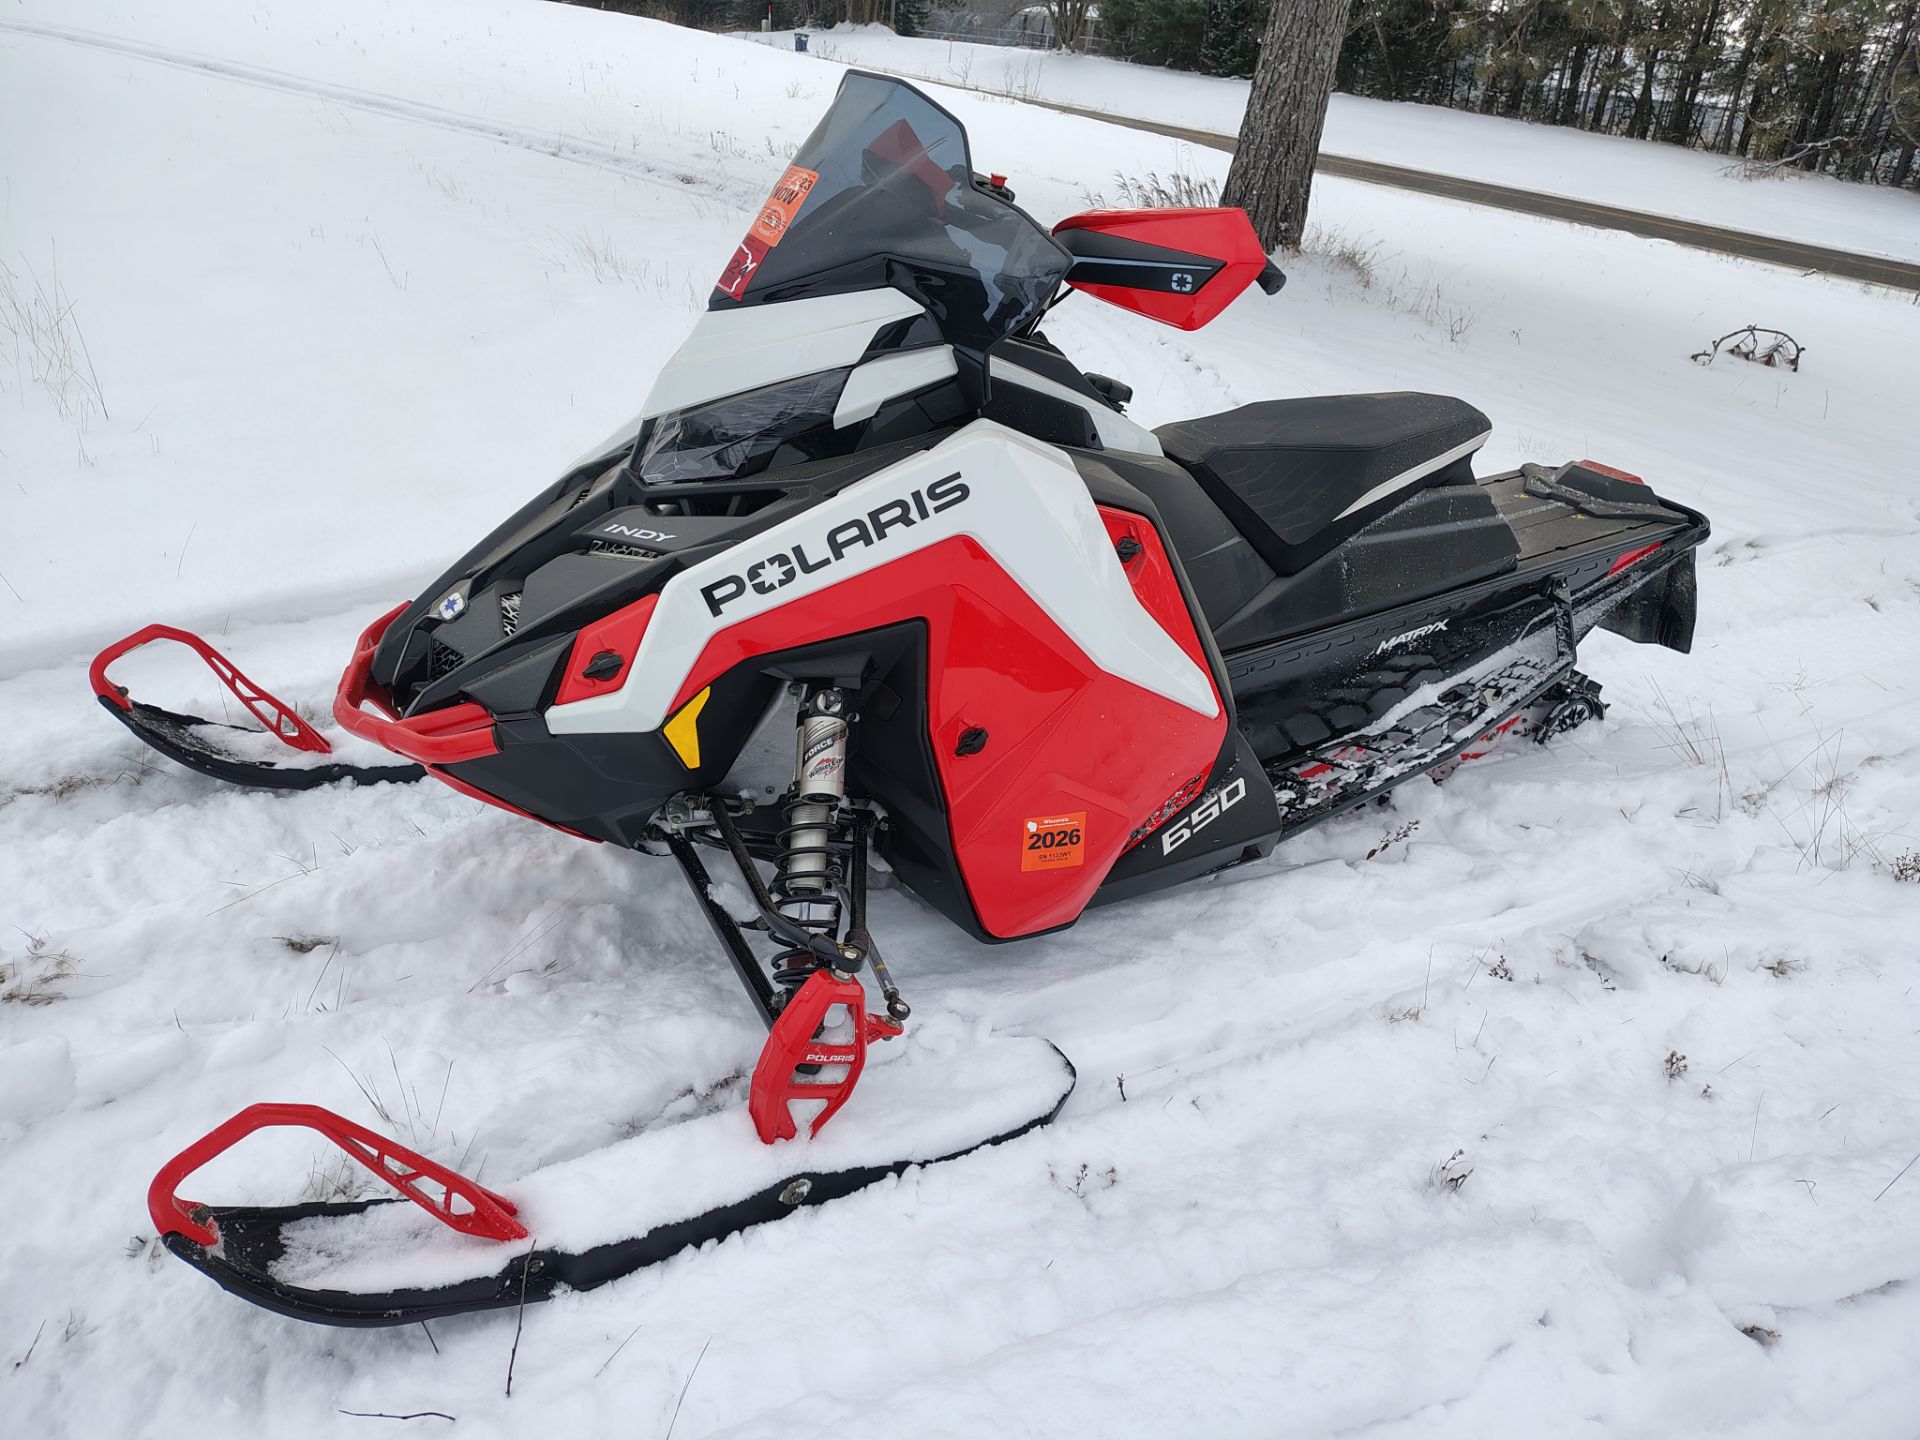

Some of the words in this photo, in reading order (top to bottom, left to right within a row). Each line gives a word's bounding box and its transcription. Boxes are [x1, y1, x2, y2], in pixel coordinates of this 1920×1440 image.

[799, 177, 813, 191] 23
[728, 259, 750, 280] 24
[603, 523, 678, 542] INDY
[700, 471, 970, 617] POLARIS
[1375, 618, 1450, 655] MATRYX
[804, 737, 833, 761] FORCE
[1161, 777, 1246, 856] 650
[1028, 828, 1081, 850] 2026
[806, 1054, 856, 1062] POLARIS
